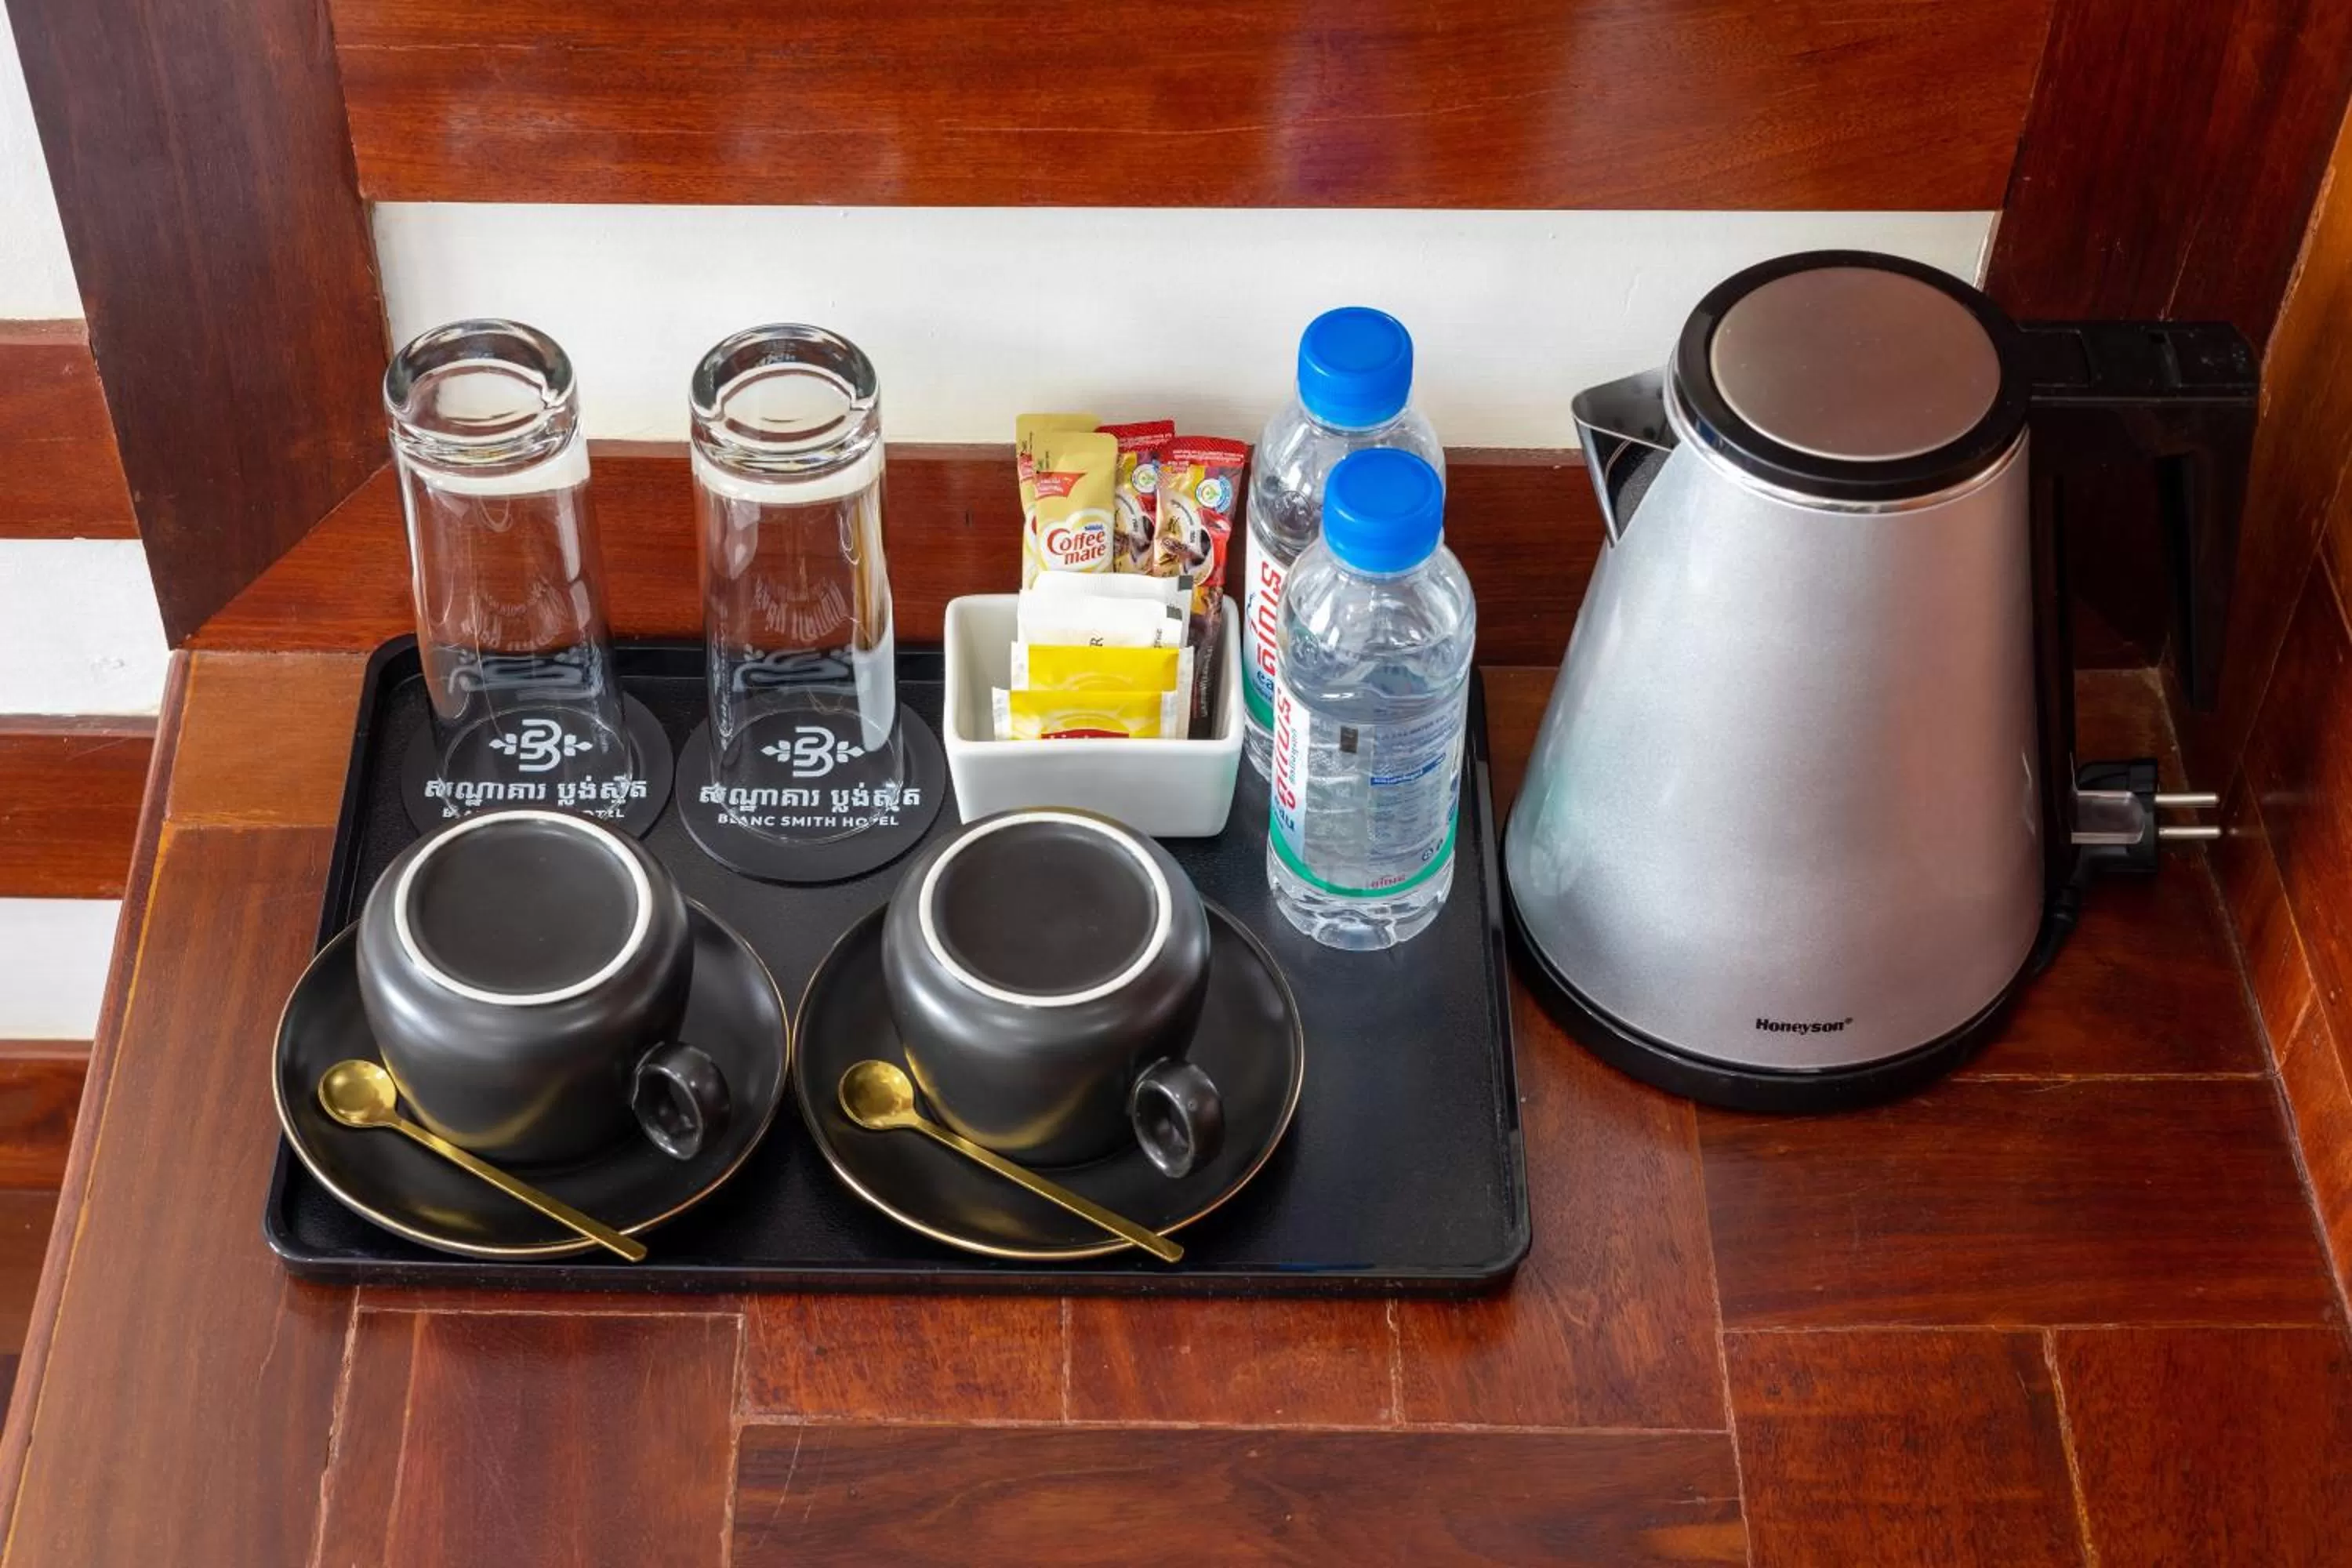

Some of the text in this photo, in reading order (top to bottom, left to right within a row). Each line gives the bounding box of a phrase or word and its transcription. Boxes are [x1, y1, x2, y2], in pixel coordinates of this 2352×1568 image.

[1047, 528, 1105, 556] Coffee
[1064, 544, 1106, 564] mate
[1257, 670, 1274, 691] ea
[583, 809, 626, 818] TEL
[717, 813, 775, 826] BLANC
[780, 816, 837, 827] SMITH
[1755, 1018, 1844, 1035] Honeyson
